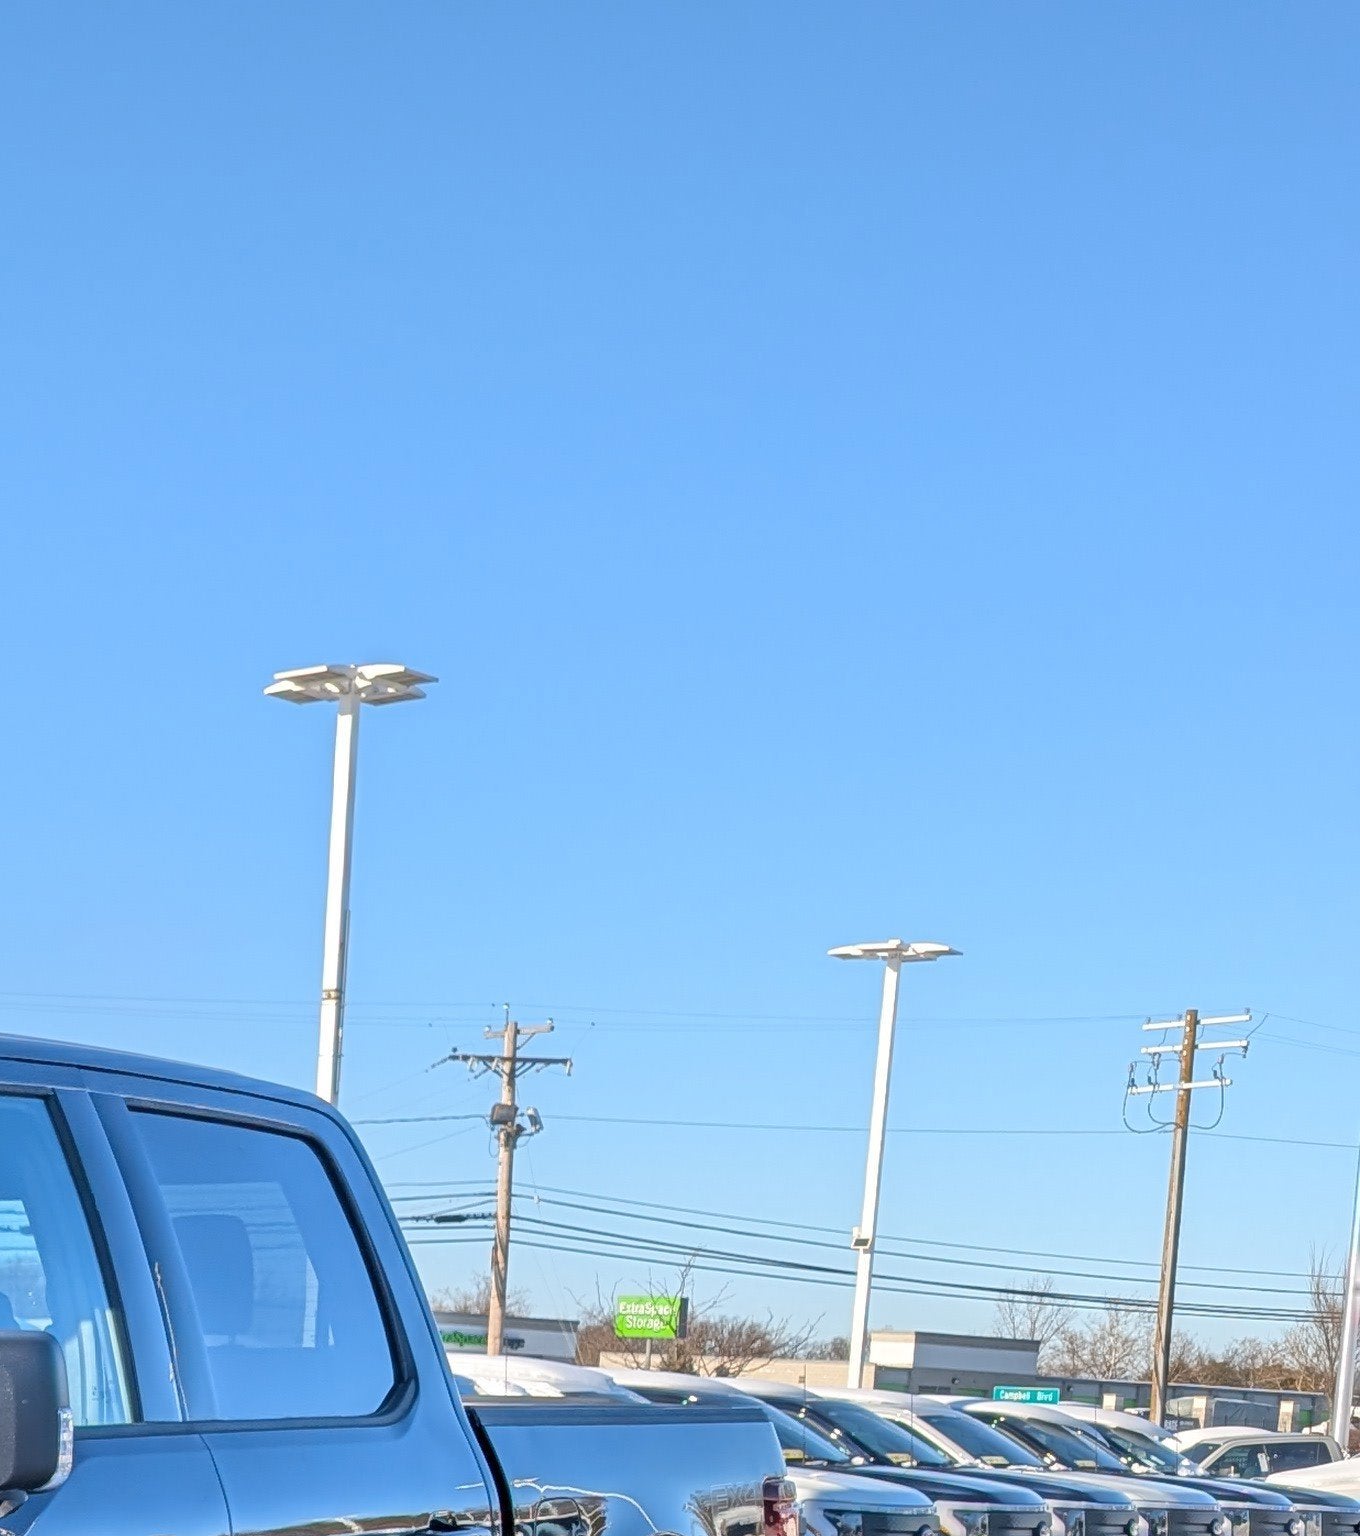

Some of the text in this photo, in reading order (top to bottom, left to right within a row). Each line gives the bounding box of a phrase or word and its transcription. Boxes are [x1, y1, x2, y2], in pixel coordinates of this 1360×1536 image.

[619, 1302, 677, 1317] ExtraSpac
[999, 1389, 1053, 1402] Campbell Blvd
